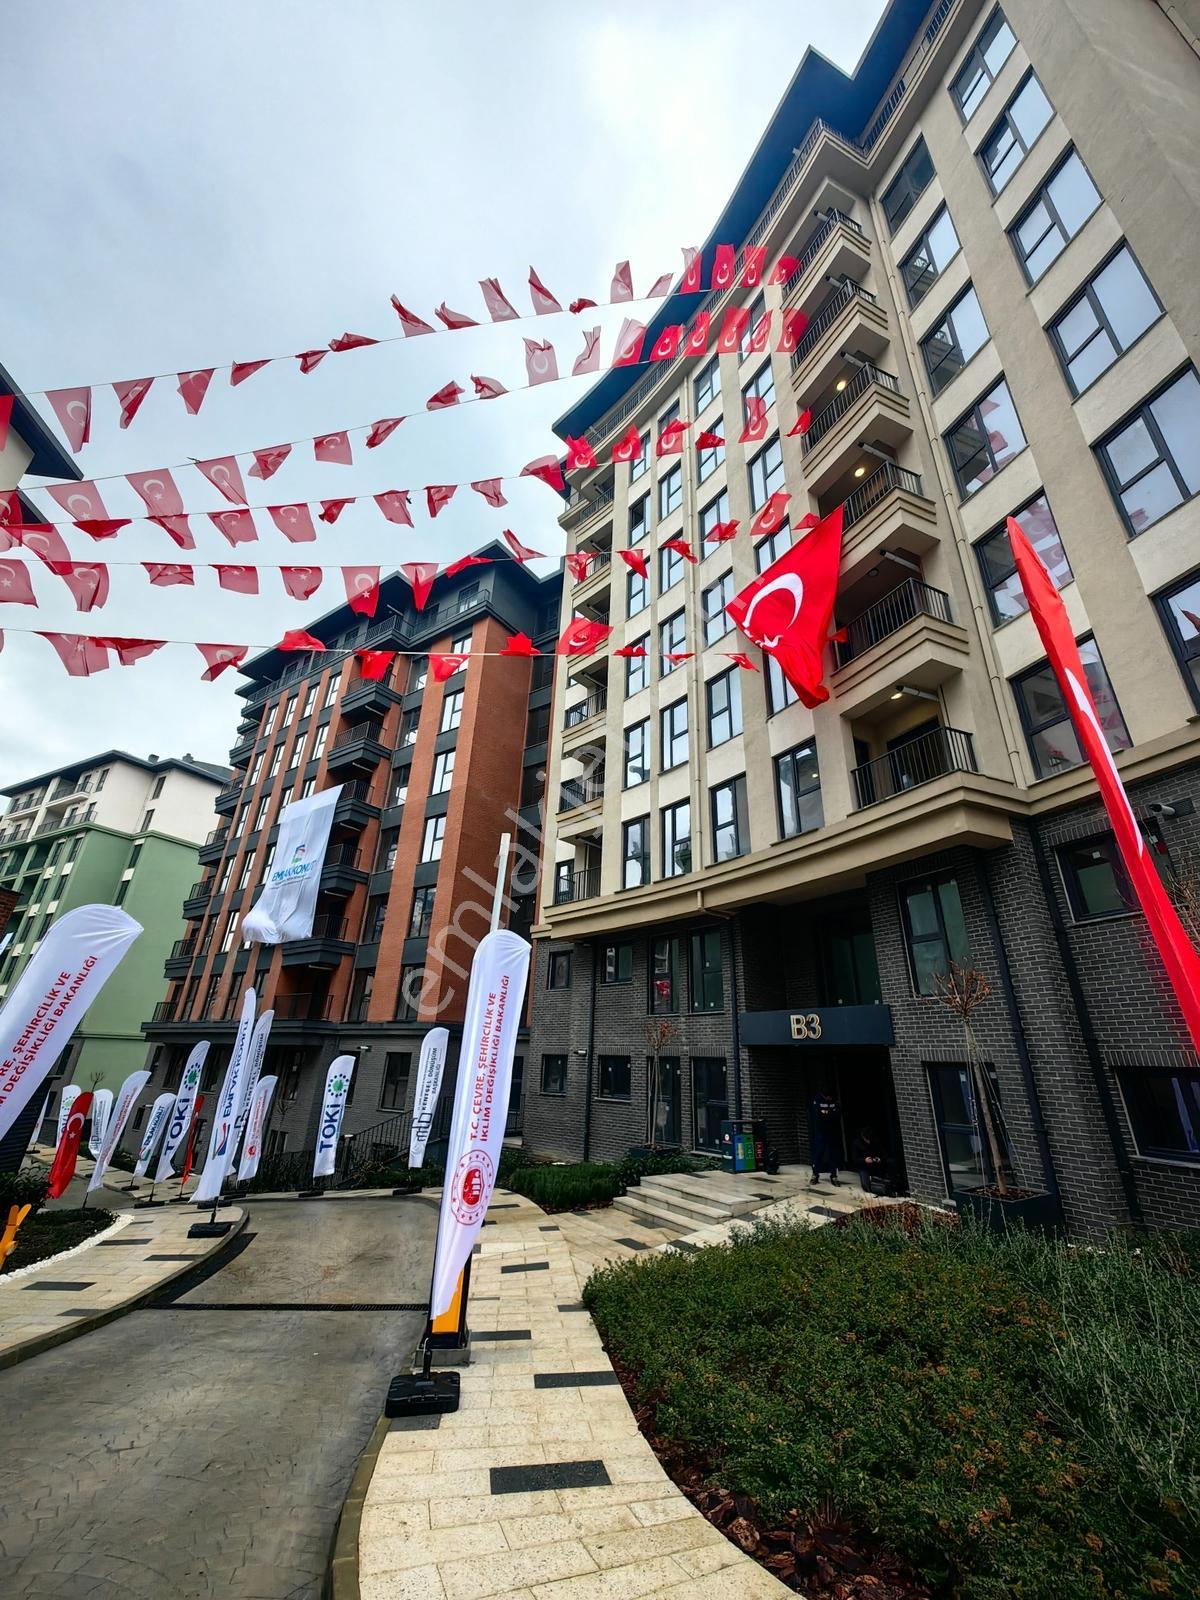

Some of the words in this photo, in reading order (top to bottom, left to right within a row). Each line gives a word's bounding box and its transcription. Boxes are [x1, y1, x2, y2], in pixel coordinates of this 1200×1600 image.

[3, 1018, 58, 1093] DEĞİŞİKLİĞİ
[53, 955, 98, 1017] BAKANLIĞI
[13, 988, 60, 1056] ŞEHİRCİLİK
[55, 971, 71, 989] VE
[488, 992, 497, 1007] VE
[478, 1009, 494, 1070] ŞEHİRCİLİK
[790, 1013, 822, 1040] B3
[480, 1107, 491, 1142] İKLİM
[495, 975, 510, 1032] BAKANLIĞI
[472, 1073, 485, 1115] ÇEVRE,
[470, 1117, 480, 1141] T.C.
